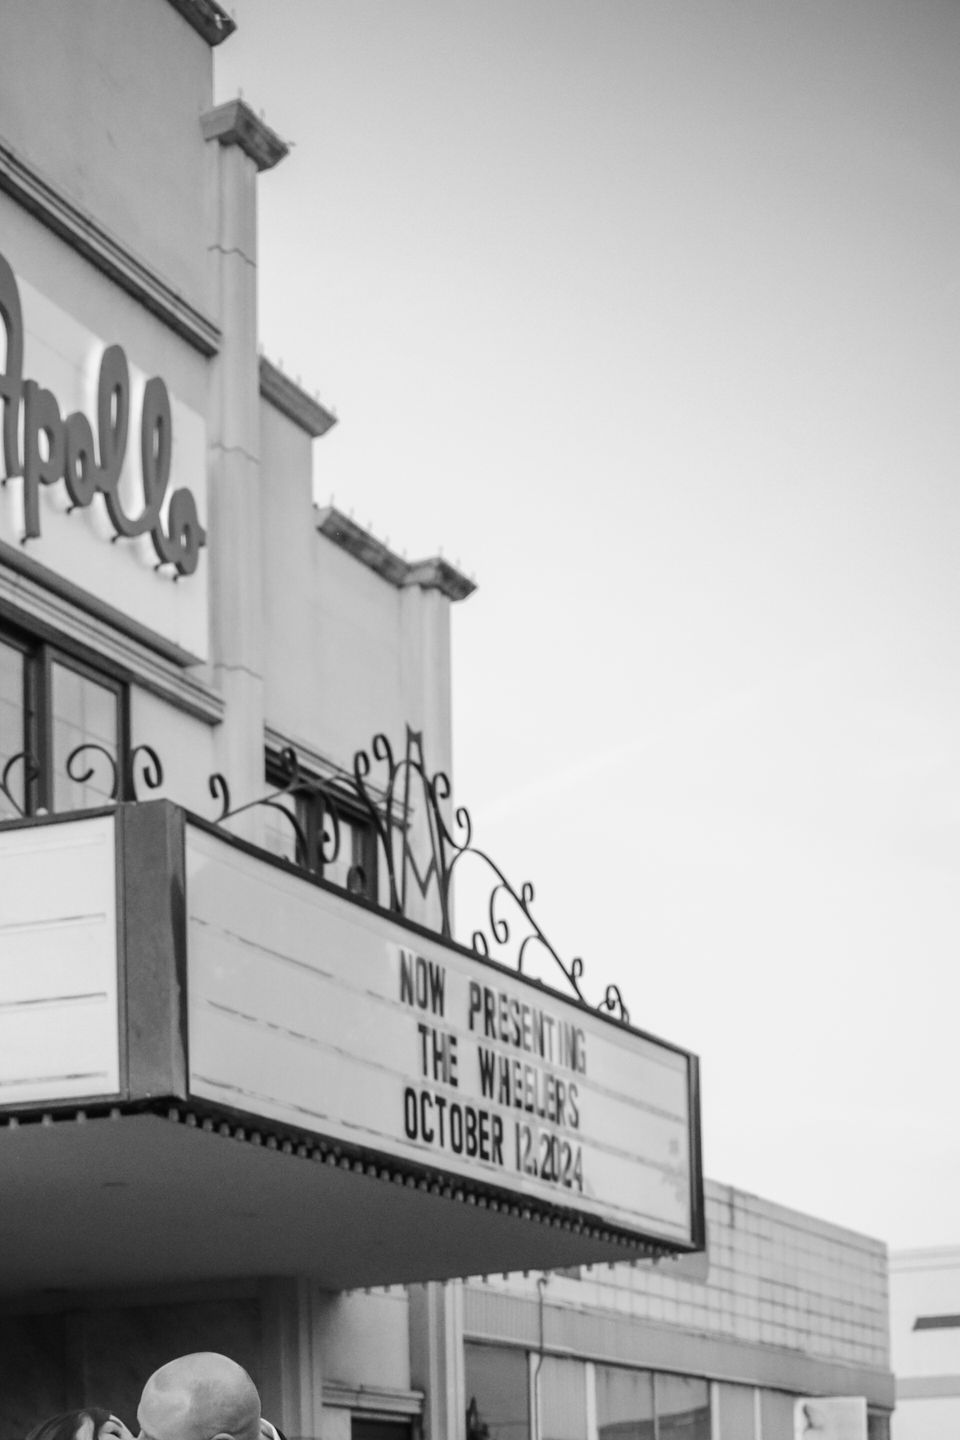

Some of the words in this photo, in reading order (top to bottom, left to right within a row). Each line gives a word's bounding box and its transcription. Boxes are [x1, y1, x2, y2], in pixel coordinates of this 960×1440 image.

[400, 949, 446, 1018] NOW
[469, 981, 587, 1075] PRESENTING
[403, 1086, 504, 1167] OCTOBER
[418, 1023, 459, 1088] THE
[478, 1045, 580, 1129] WHEELERS
